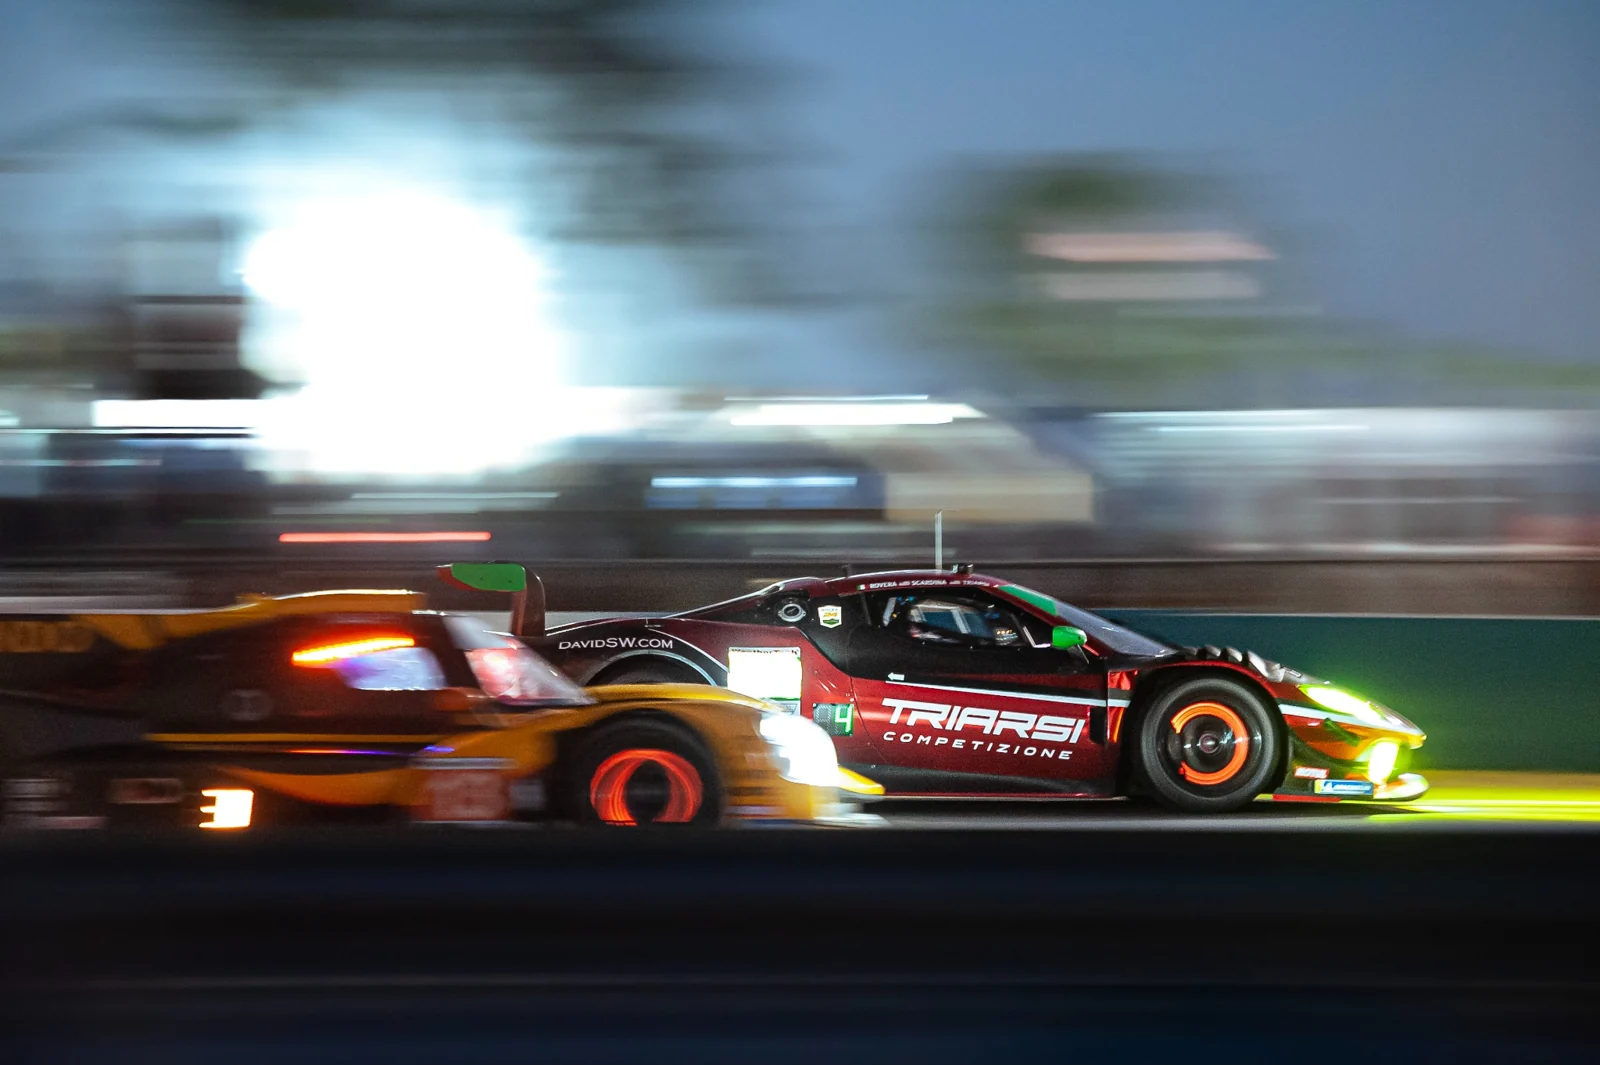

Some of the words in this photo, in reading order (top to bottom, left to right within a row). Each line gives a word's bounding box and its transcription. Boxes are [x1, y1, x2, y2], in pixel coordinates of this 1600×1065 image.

[834, 704, 854, 733] 4
[881, 697, 1086, 744] TRIARSI
[883, 731, 1074, 760] COMPETIZIONE
